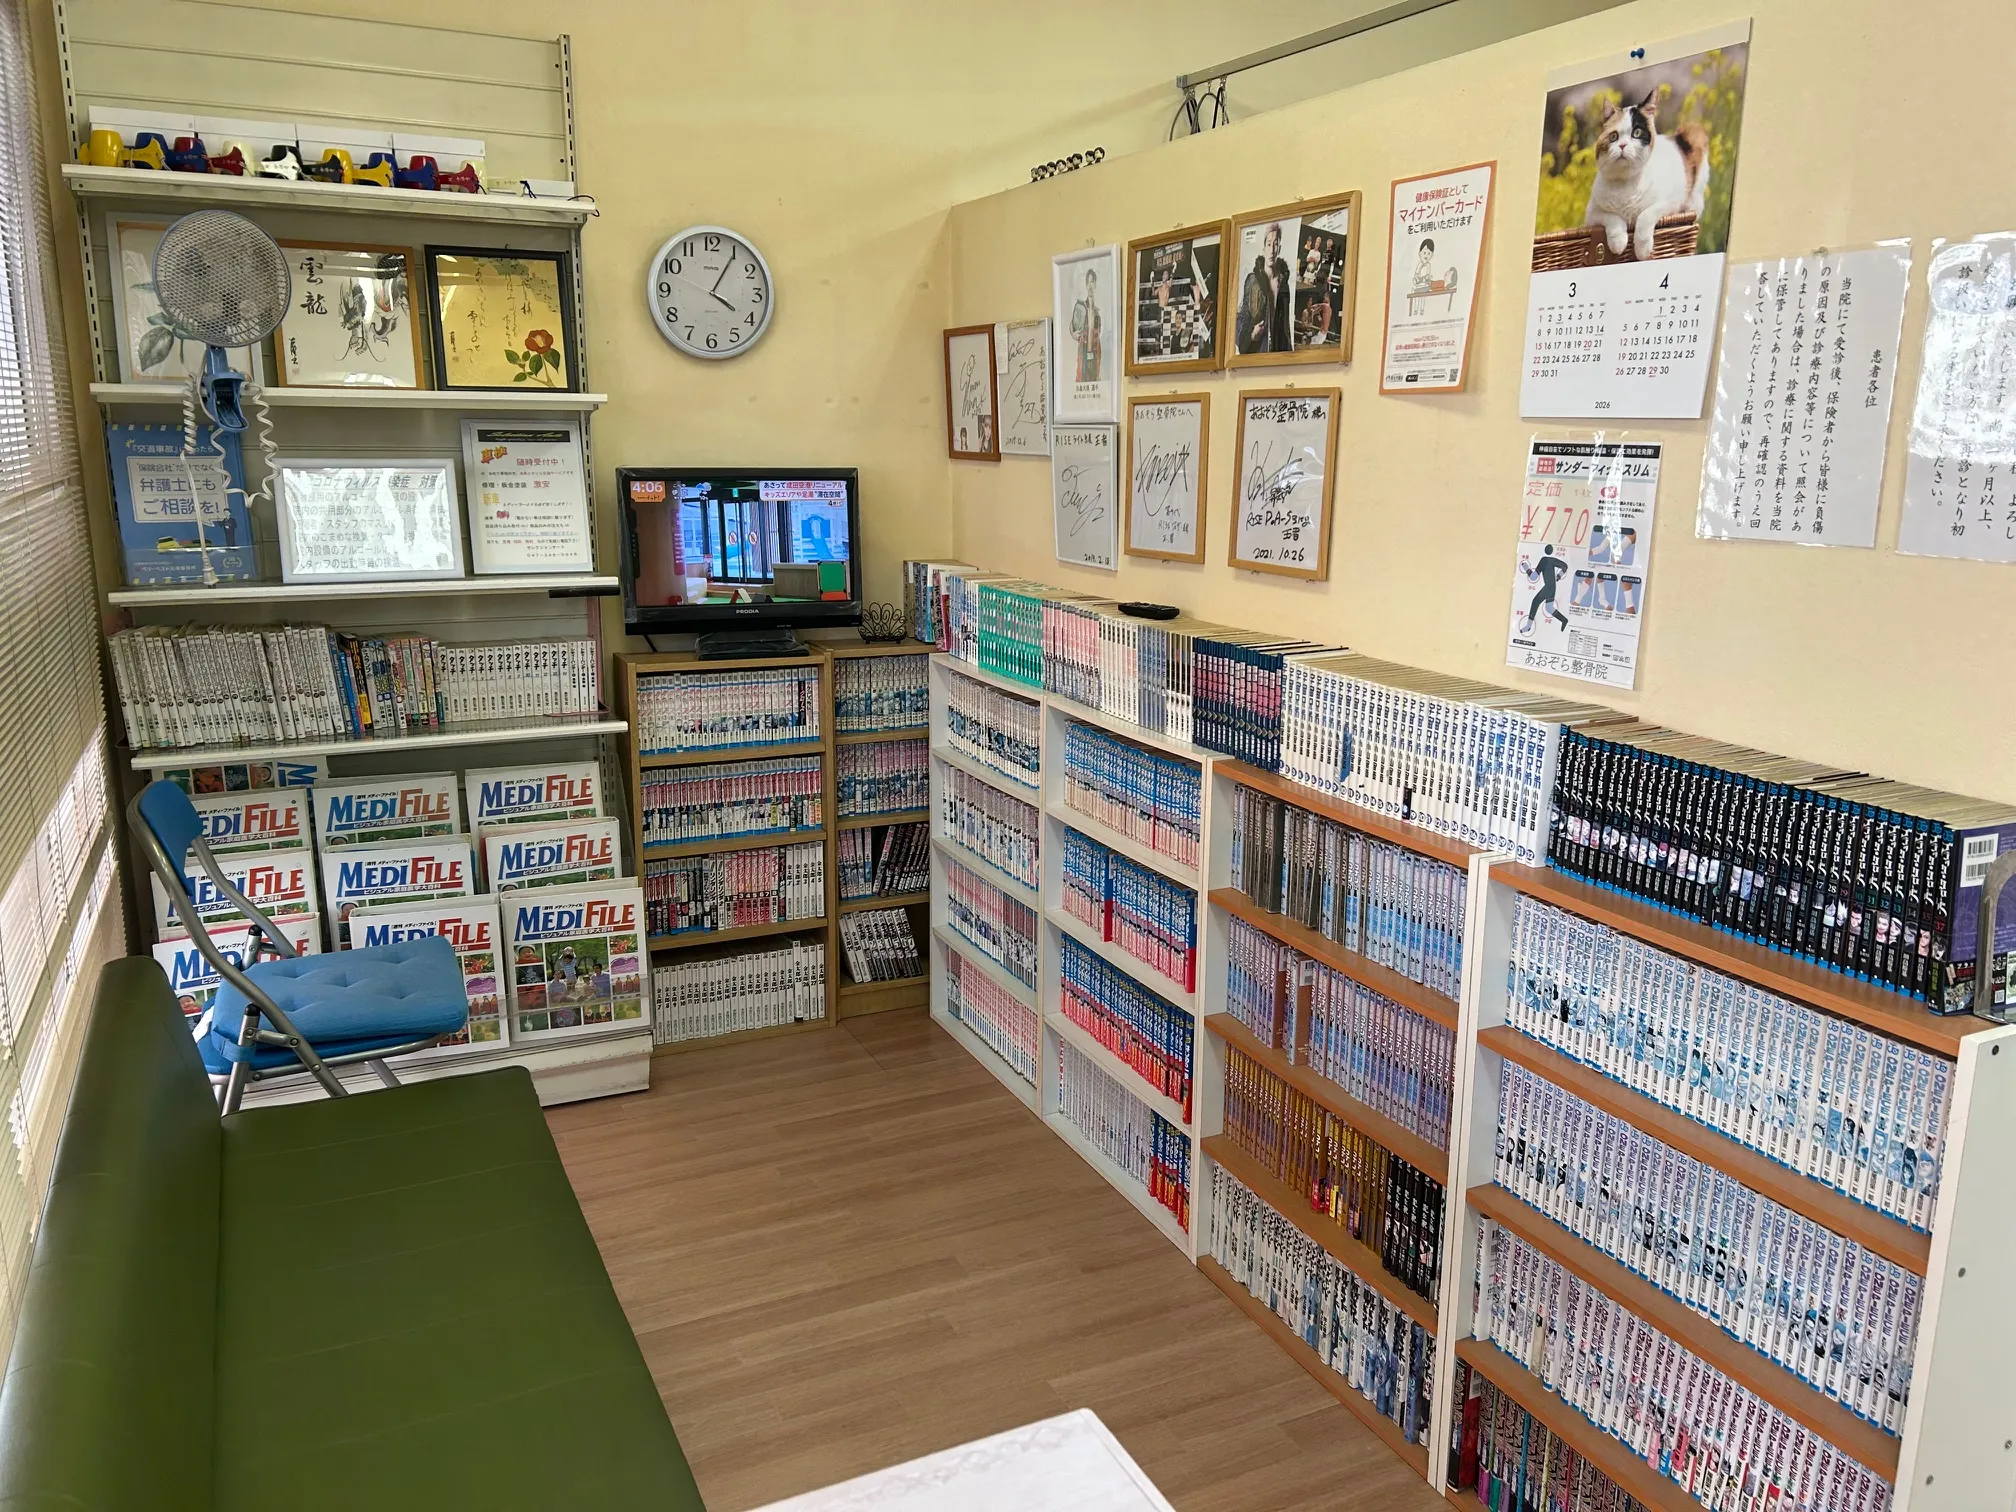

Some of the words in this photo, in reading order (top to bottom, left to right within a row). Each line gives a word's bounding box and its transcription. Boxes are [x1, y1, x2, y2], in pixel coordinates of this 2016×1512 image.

[1416, 184, 1469, 203] 健康保険証として
[1400, 195, 1483, 222] マイナンバーカード
[1408, 216, 1473, 234] をご利用いただけます
[683, 241, 694, 257] 11
[705, 236, 720, 251] 12
[732, 245, 736, 260] 1
[665, 258, 682, 274] 10
[744, 264, 756, 279] 2
[1659, 273, 1669, 289] 4
[659, 282, 671, 298] 9
[752, 288, 762, 303] 3
[1569, 283, 1576, 297] 3
[666, 307, 678, 322] 8
[744, 311, 755, 326] 4
[684, 325, 694, 340] 7
[706, 333, 718, 348] 6
[730, 328, 740, 342] 5
[1688, 335, 1697, 343] 18
[1628, 352, 1637, 360] 20
[1685, 350, 1694, 358] 25
[1865, 349, 1883, 408] 患者各位
[1770, 267, 1808, 531] りました場合は、診療に関する資料を当院
[1792, 267, 1831, 532] の原因及び診療内容等について照会があ
[1812, 277, 1852, 534] 当院にて受診後、保険者から皆様に負傷
[140, 478, 216, 492] 弁護士にも
[633, 482, 662, 492] 4:06
[1527, 481, 1563, 497] 定価
[144, 498, 220, 515] ご相談を!
[1522, 505, 1590, 545] ¥770
[1525, 651, 1609, 680] あおぞら整骨院
[478, 774, 593, 817] MEDIFILE
[326, 788, 451, 832] MEDIFILE
[200, 802, 299, 838] EDIFILE
[498, 834, 612, 880] MEDIFILE
[336, 856, 463, 897] MEDIFILE
[514, 900, 635, 941] MEDIFILE
